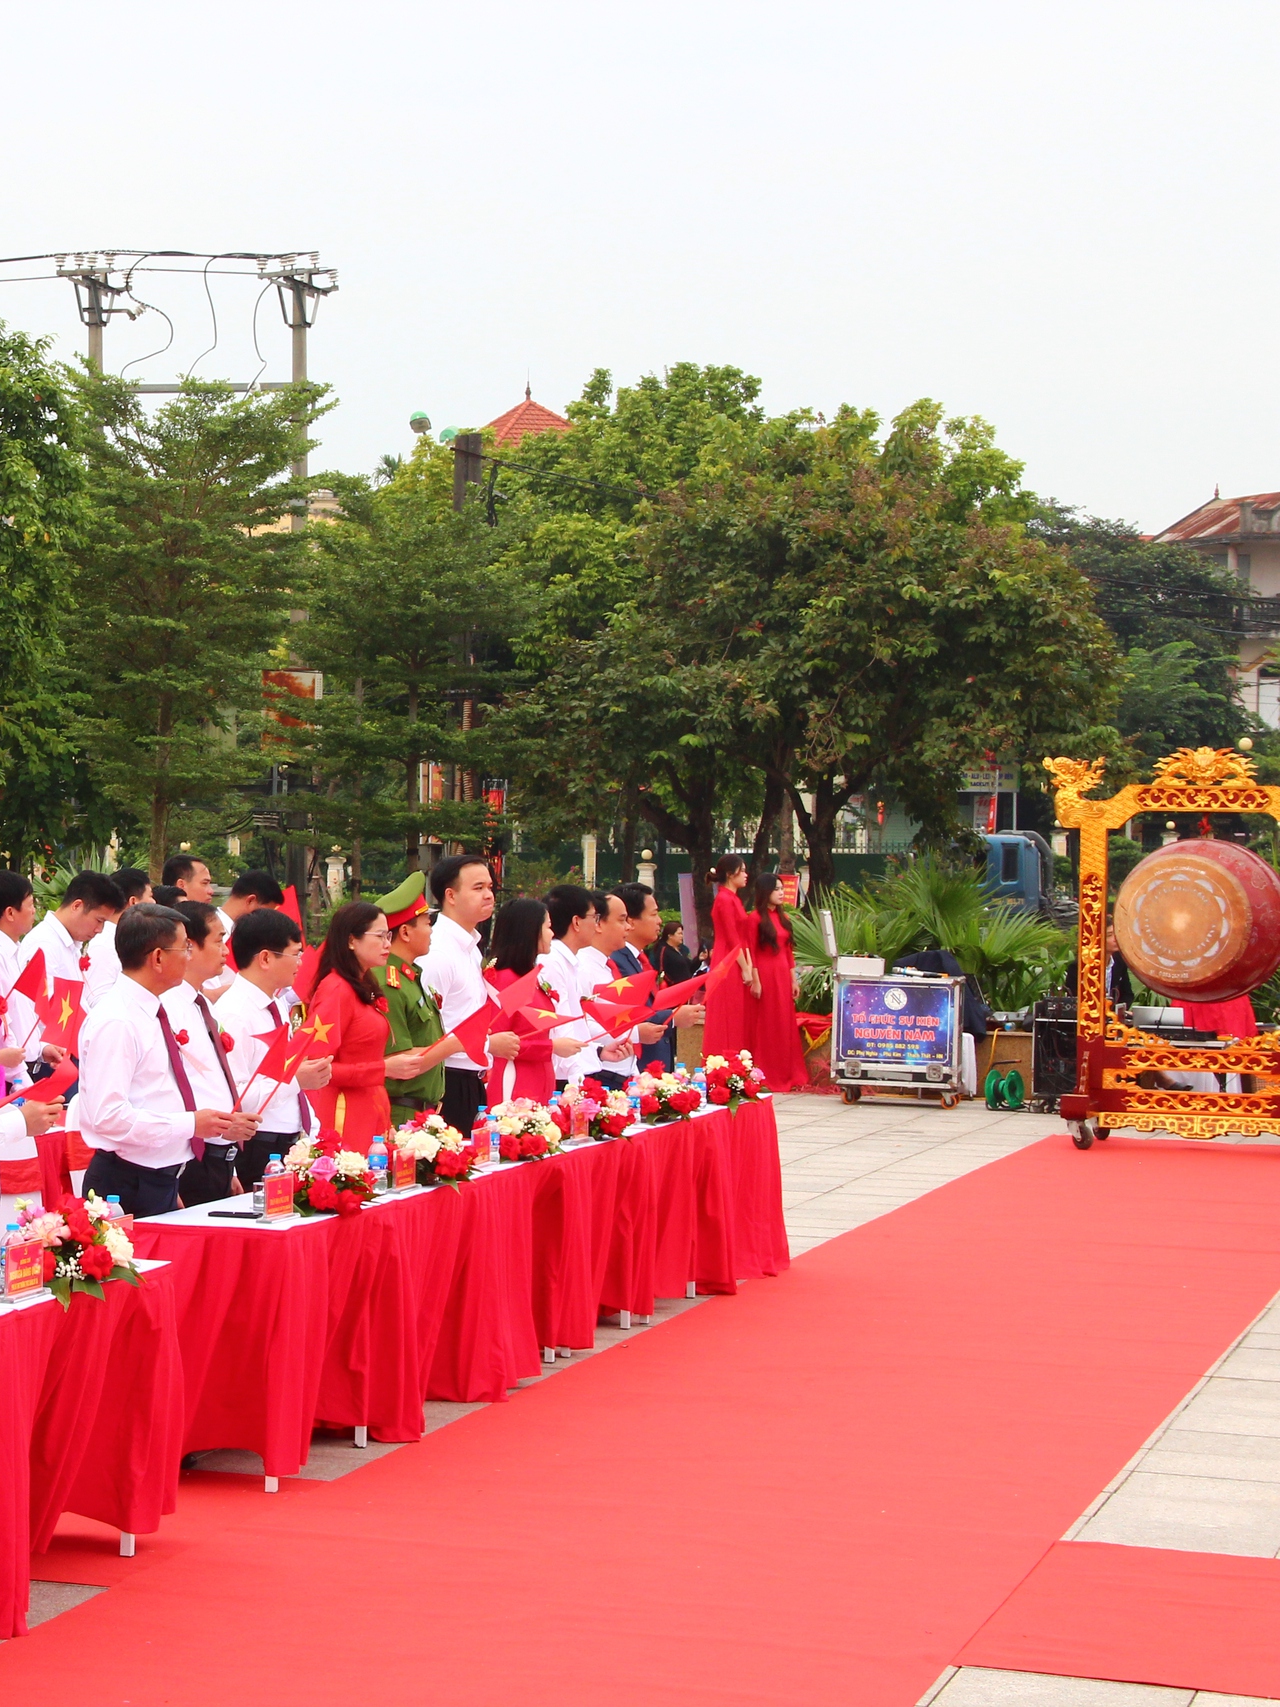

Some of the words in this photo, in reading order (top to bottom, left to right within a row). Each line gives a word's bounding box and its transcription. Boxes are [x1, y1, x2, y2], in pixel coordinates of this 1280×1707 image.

[898, 1015, 915, 1027] SỰ
[916, 1015, 940, 1028] KIỆN
[854, 1025, 902, 1040] NGUYỄN
